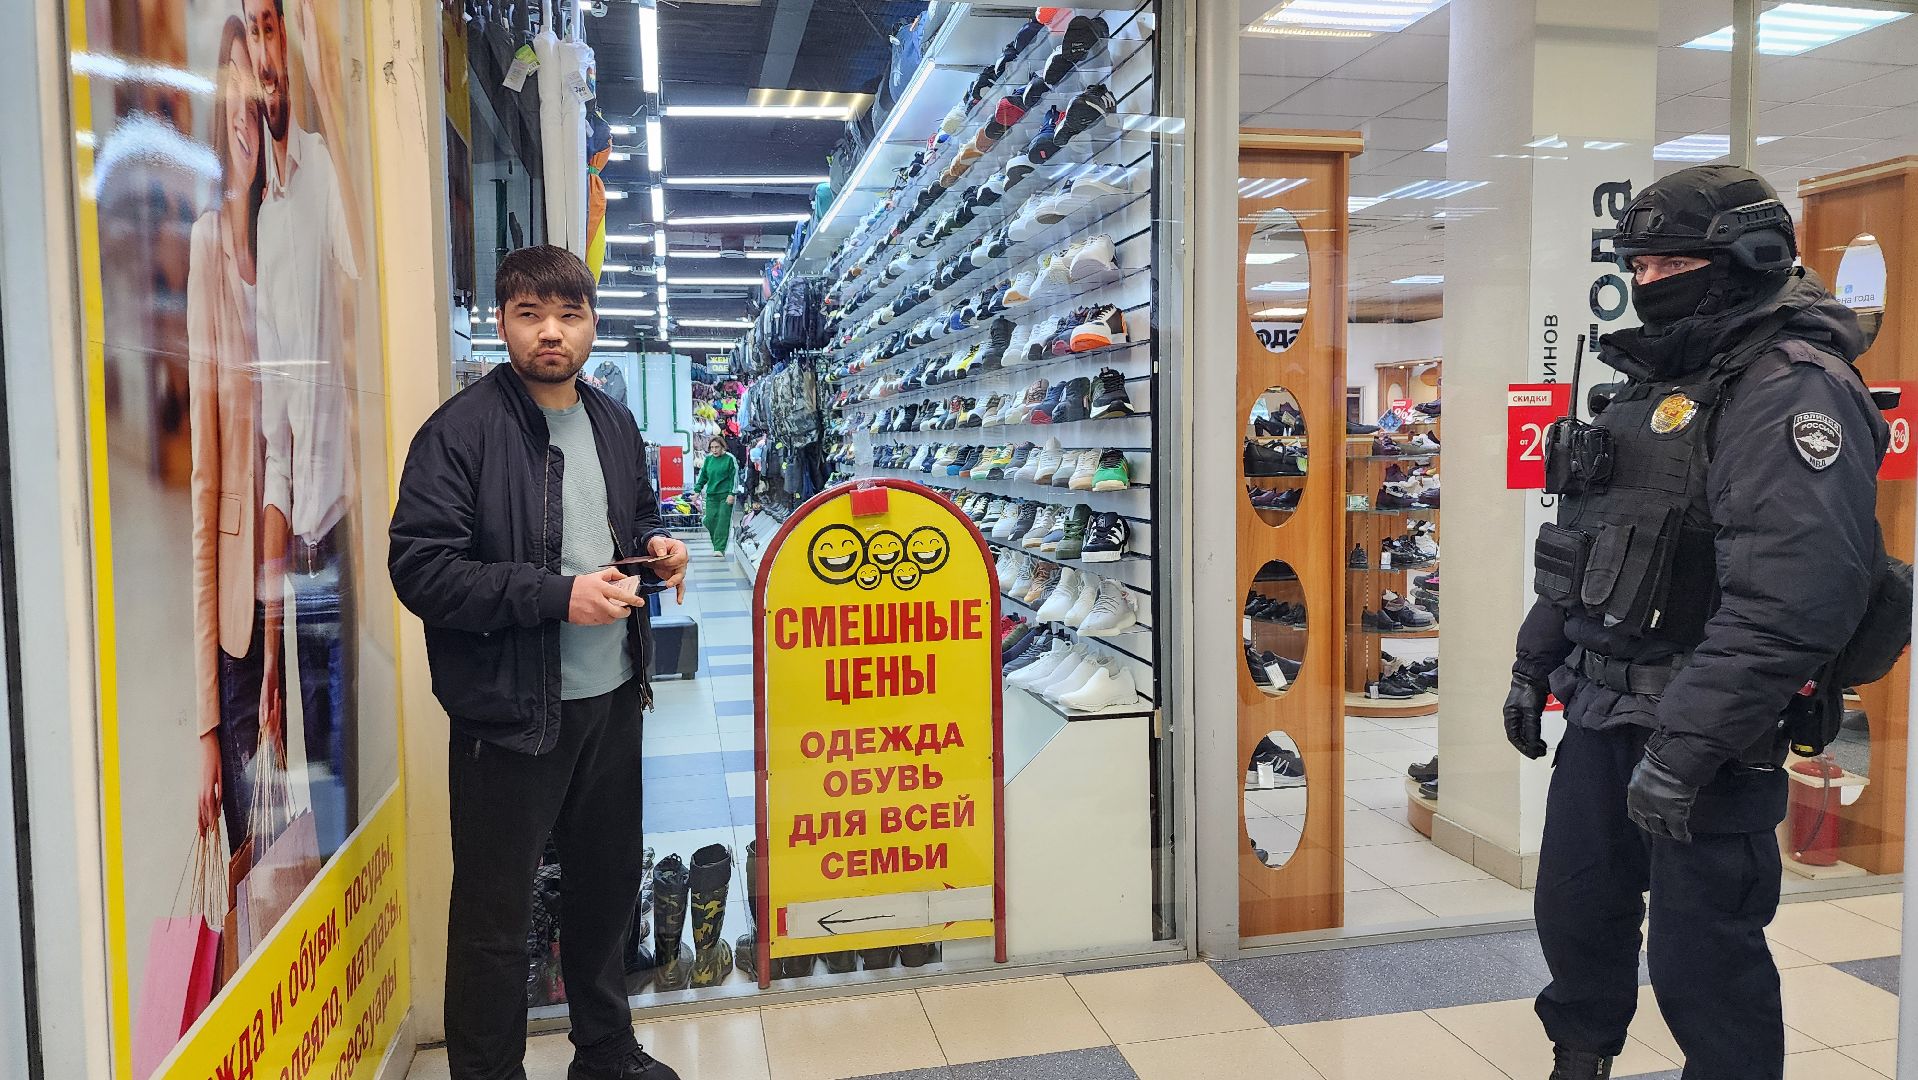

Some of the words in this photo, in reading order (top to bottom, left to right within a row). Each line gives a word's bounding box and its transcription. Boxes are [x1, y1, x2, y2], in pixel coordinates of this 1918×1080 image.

[1801, 422, 1836, 438] РОССИЯ
[774, 599, 983, 650] СМЕШНЫЕ
[825, 653, 936, 705] ЦЕНЫ
[800, 721, 965, 763] ОДЕЖДА
[823, 763, 944, 797] ОБУВЬ
[788, 809, 867, 848] ДЛЯ
[880, 793, 976, 834] ВСЕЙ
[820, 843, 948, 880] СЕМЬИ
[270, 980, 284, 1036] и
[288, 906, 340, 1008] обуви,
[344, 833, 394, 928] посуды,
[345, 889, 402, 1004] матрасы,
